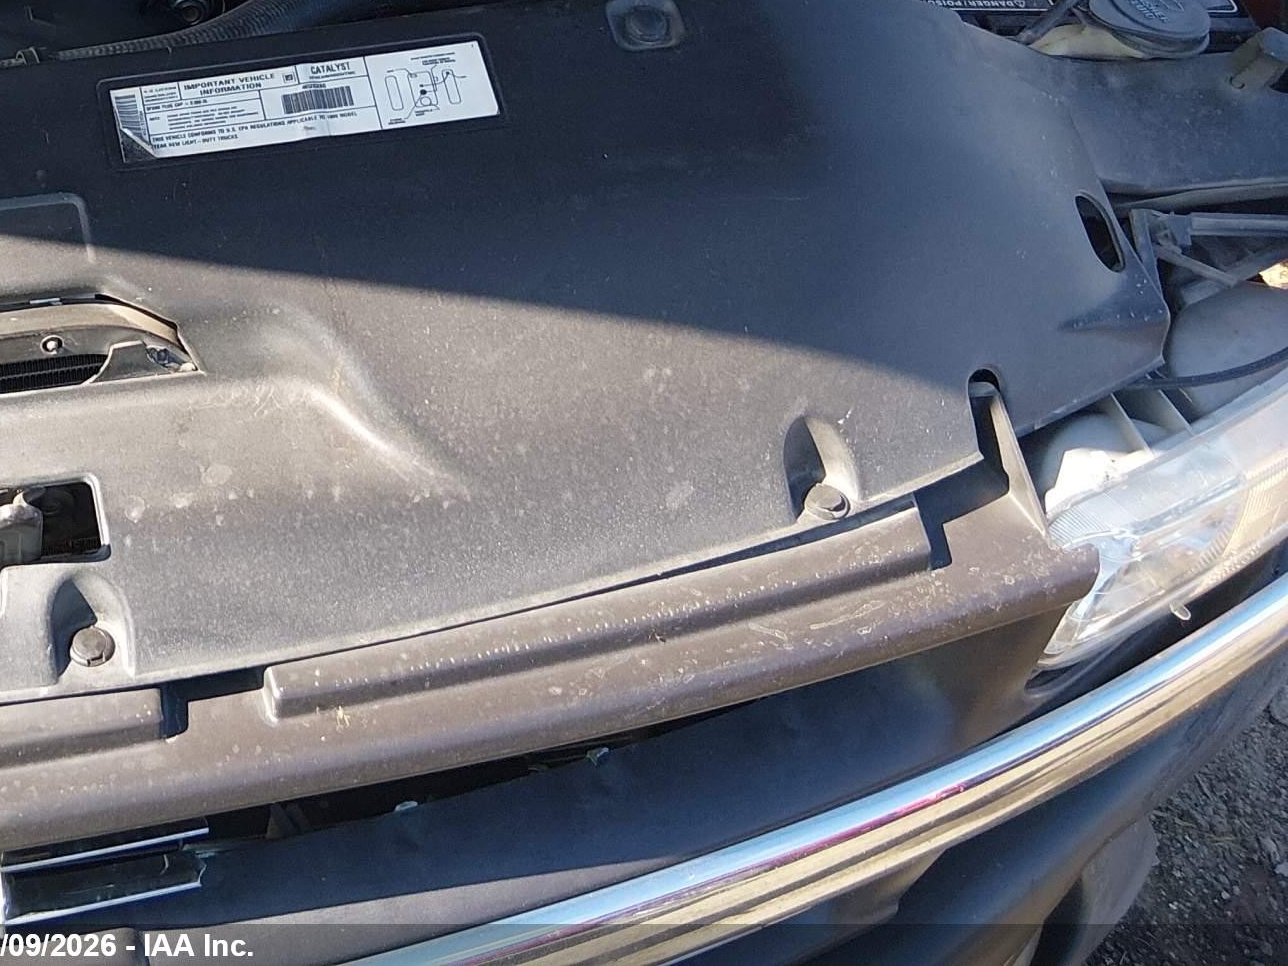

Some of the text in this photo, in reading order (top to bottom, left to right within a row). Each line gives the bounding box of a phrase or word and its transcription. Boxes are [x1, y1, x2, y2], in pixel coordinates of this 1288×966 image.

[310, 61, 351, 75] CATALYST
[184, 73, 275, 91] IMPORTANT VEHICLE
[200, 82, 262, 96] INFORMATION
[165, 133, 187, 141] VEHICLE
[187, 130, 216, 139] CONFORMS
[250, 120, 286, 130] REGULATIONS
[287, 114, 317, 125] APPLICABLE
[153, 142, 168, 151] YEAR
[218, 133, 239, 143] TRUCKS
